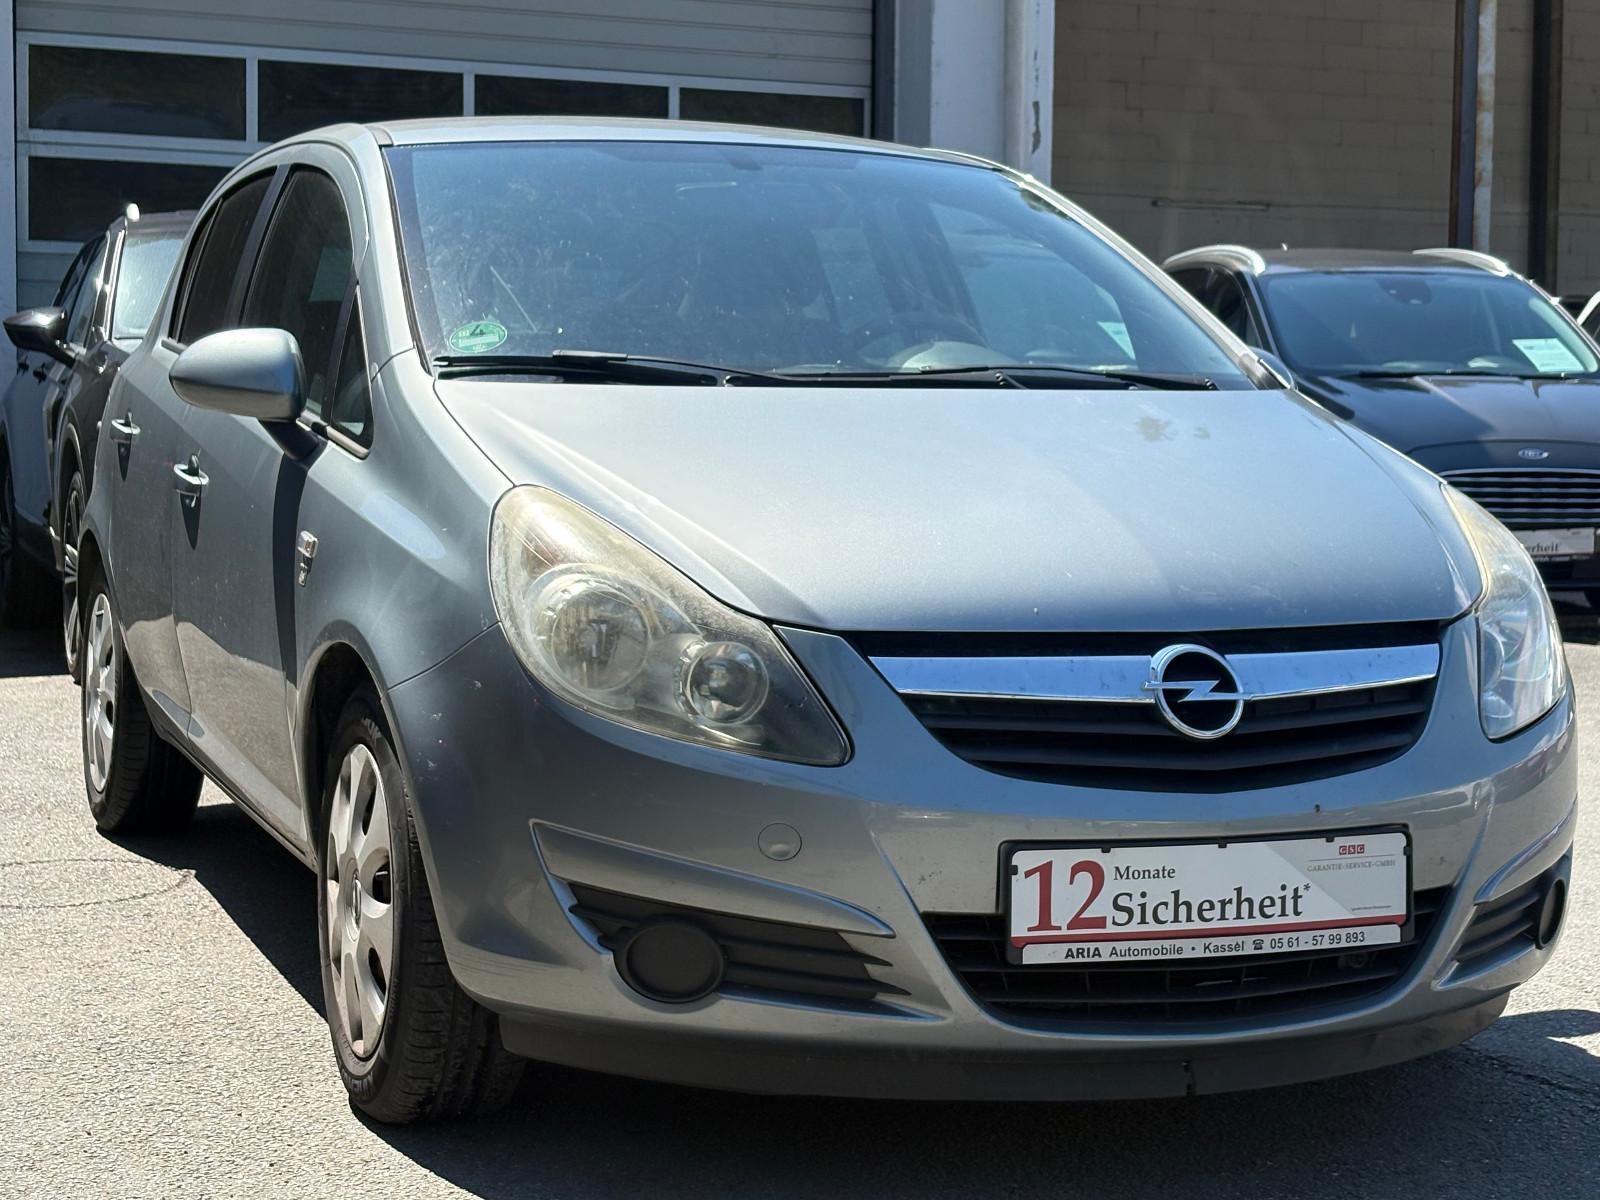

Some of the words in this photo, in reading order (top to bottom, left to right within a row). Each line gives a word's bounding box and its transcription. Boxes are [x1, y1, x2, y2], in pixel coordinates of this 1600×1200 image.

[1113, 865, 1176, 880] Monate
[1024, 860, 1107, 932] 12
[1064, 947, 1102, 959] ARIA
[1109, 944, 1184, 958] Automobile
[1203, 940, 1245, 954] Kassel
